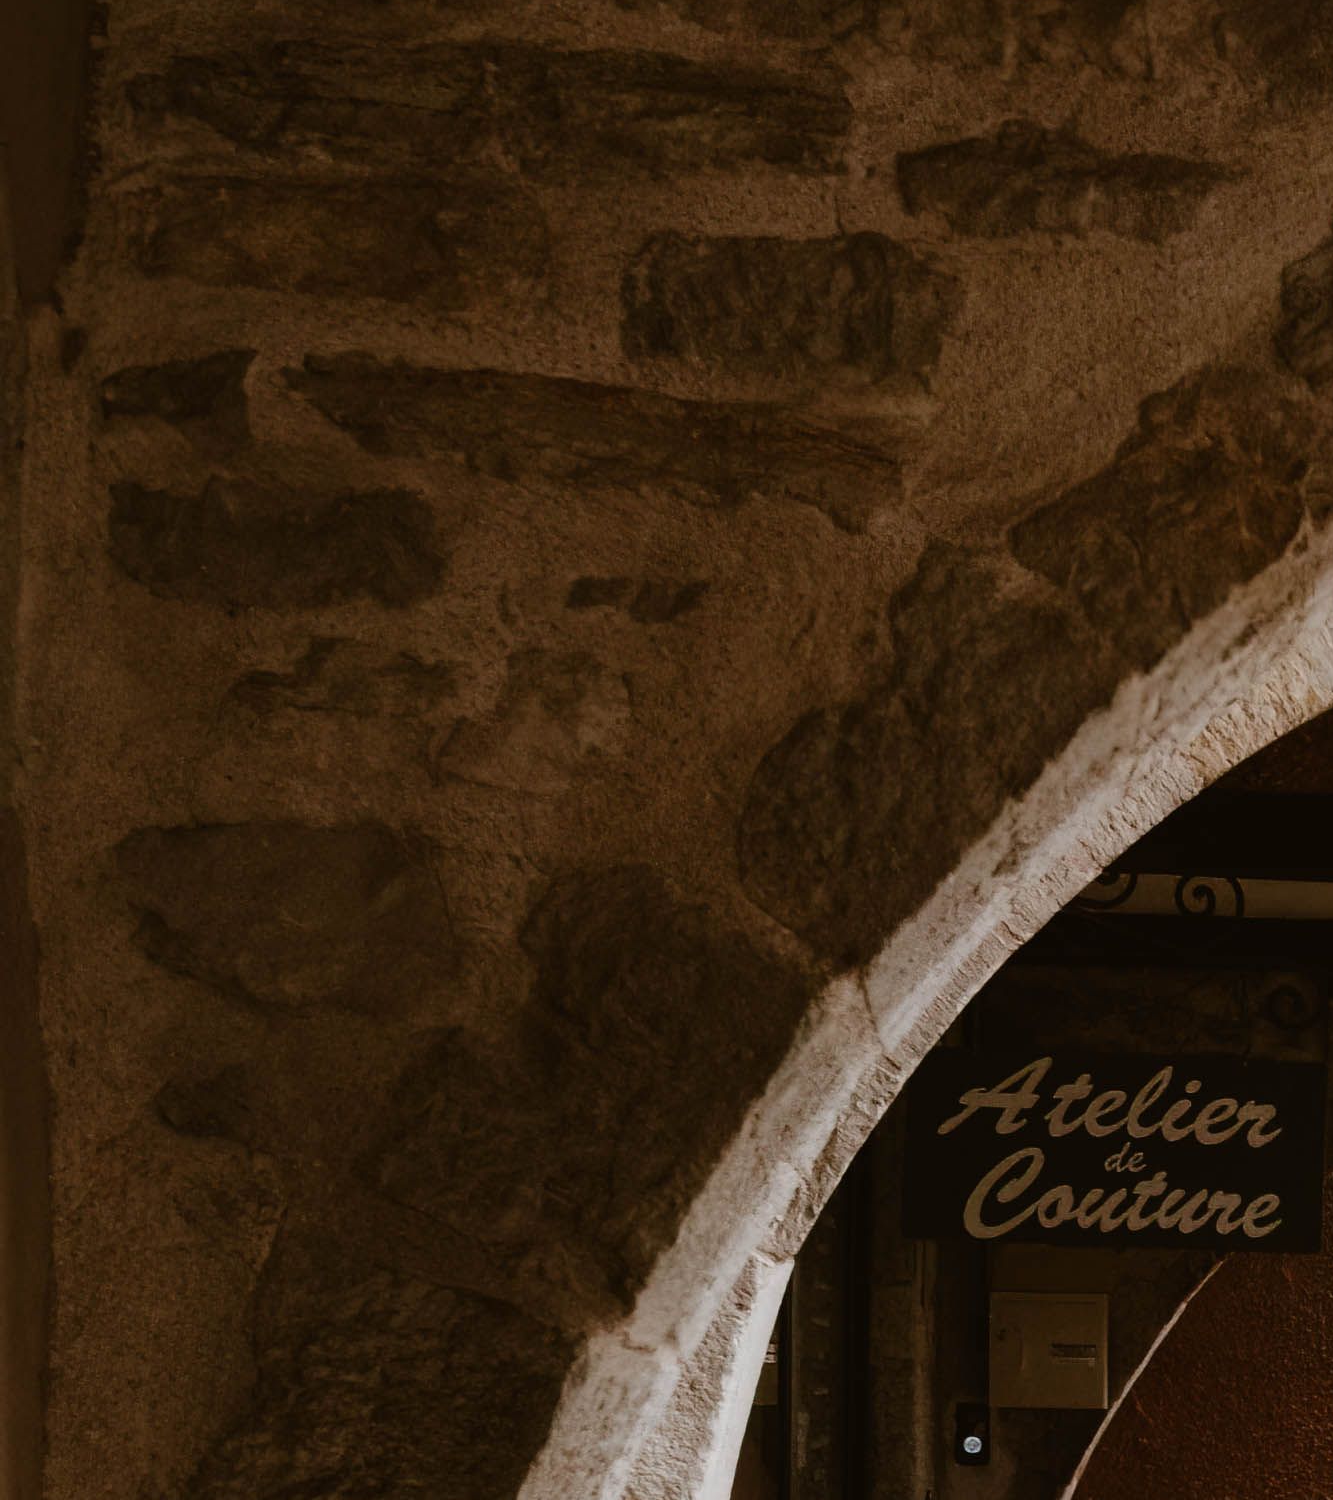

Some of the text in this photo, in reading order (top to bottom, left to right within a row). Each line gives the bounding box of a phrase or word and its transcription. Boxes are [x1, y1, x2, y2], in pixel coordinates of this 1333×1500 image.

[937, 1056, 1282, 1148] Atelier
[963, 1147, 1282, 1239] Couture
[1104, 1142, 1147, 1172] de
